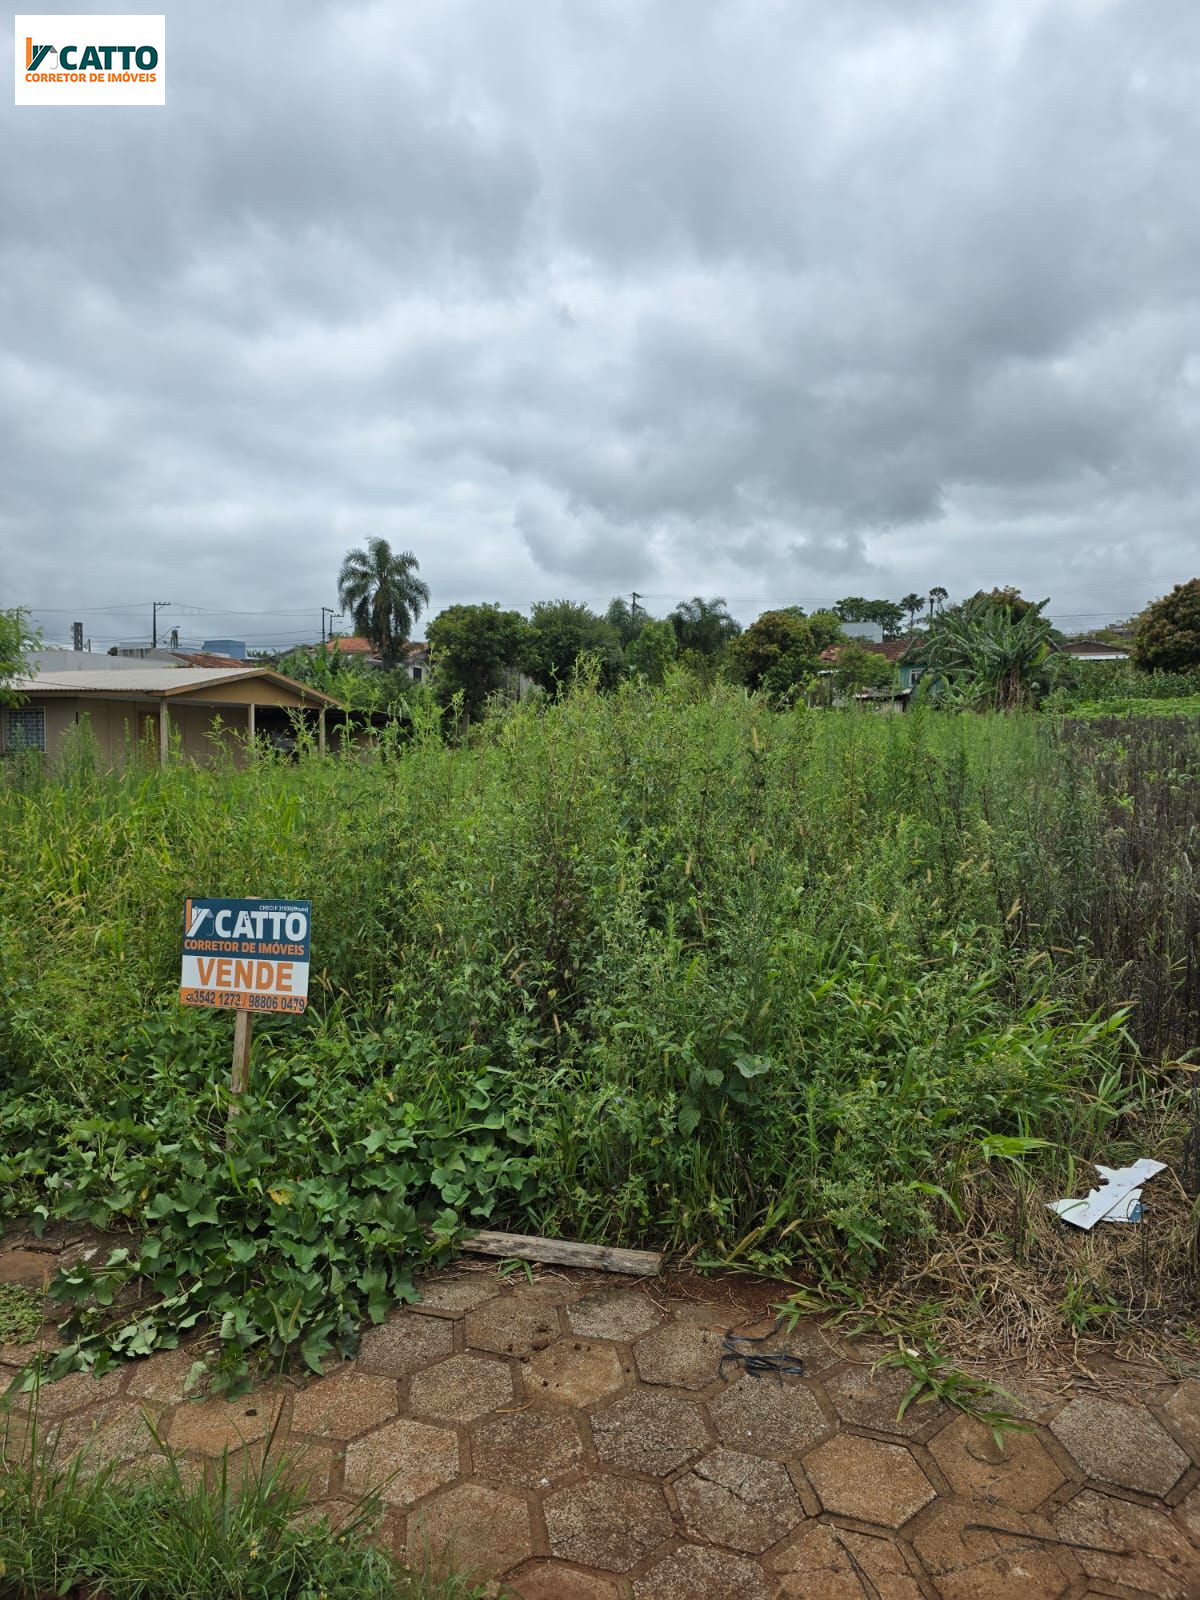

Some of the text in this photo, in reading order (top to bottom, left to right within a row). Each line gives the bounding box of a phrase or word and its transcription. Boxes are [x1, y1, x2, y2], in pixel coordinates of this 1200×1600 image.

[214, 909, 308, 942] CATTO
[184, 939, 305, 956] CORRETOR DE IMÓVEIS
[196, 957, 294, 993] VENDE
[248, 995, 278, 1009] 98806
[281, 997, 306, 1012] 0479
